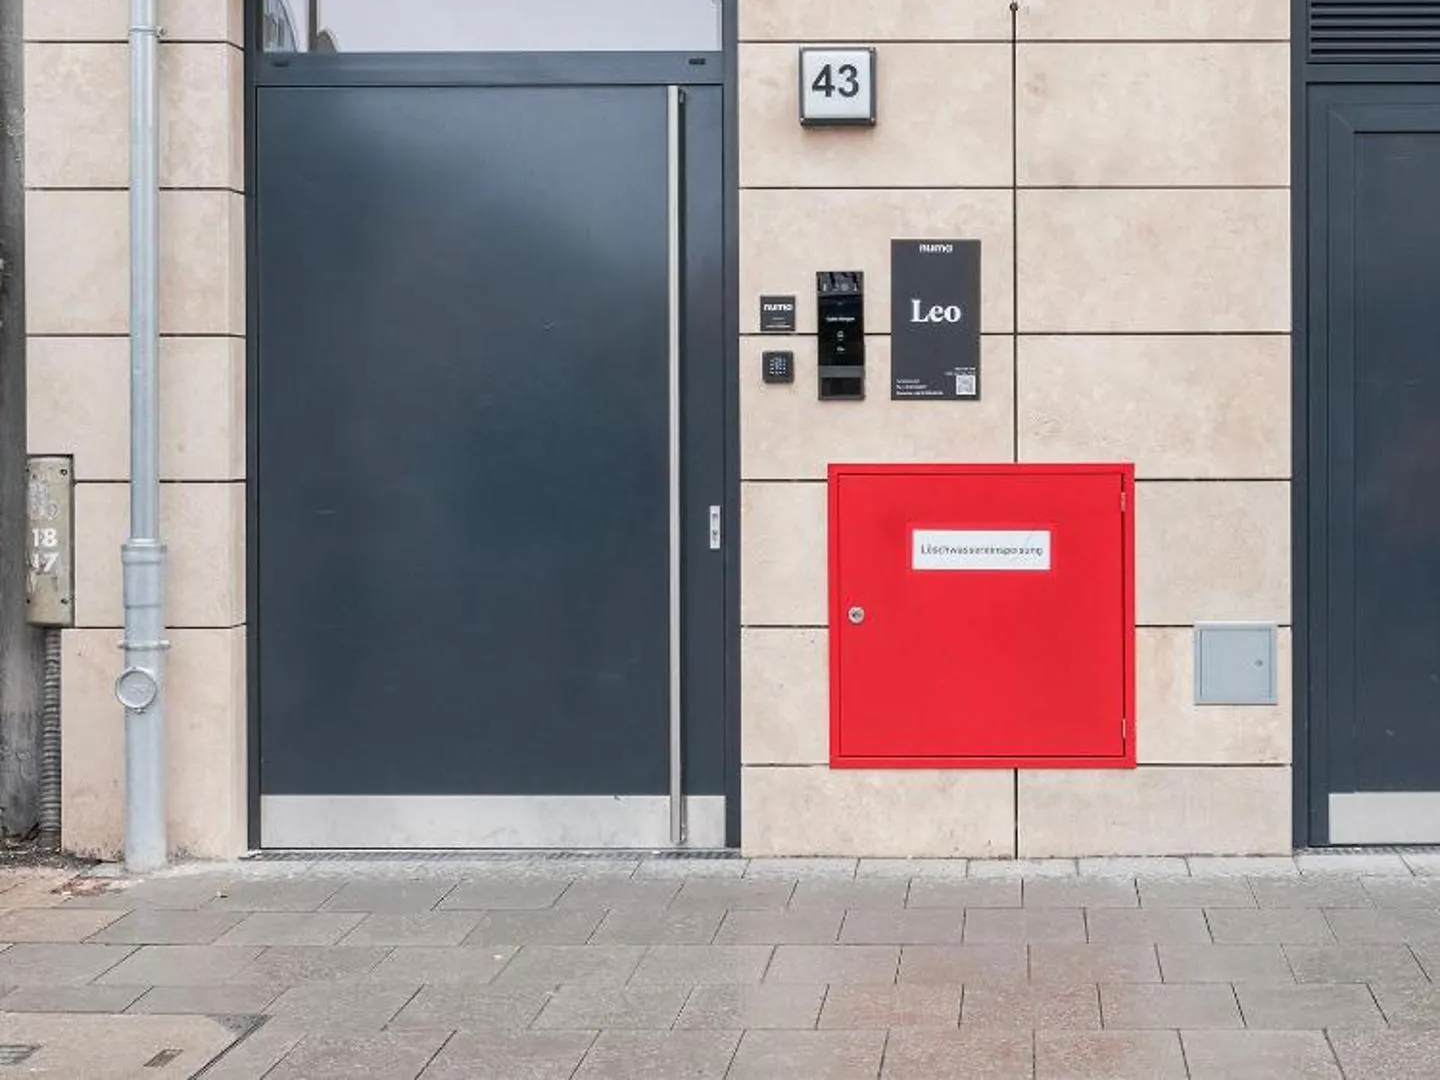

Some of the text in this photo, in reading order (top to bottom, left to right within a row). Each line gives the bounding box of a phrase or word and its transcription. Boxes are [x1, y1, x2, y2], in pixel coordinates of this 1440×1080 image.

[811, 64, 860, 98] 43
[919, 244, 953, 253] numa
[910, 299, 961, 322] Leo
[32, 528, 57, 547] 18
